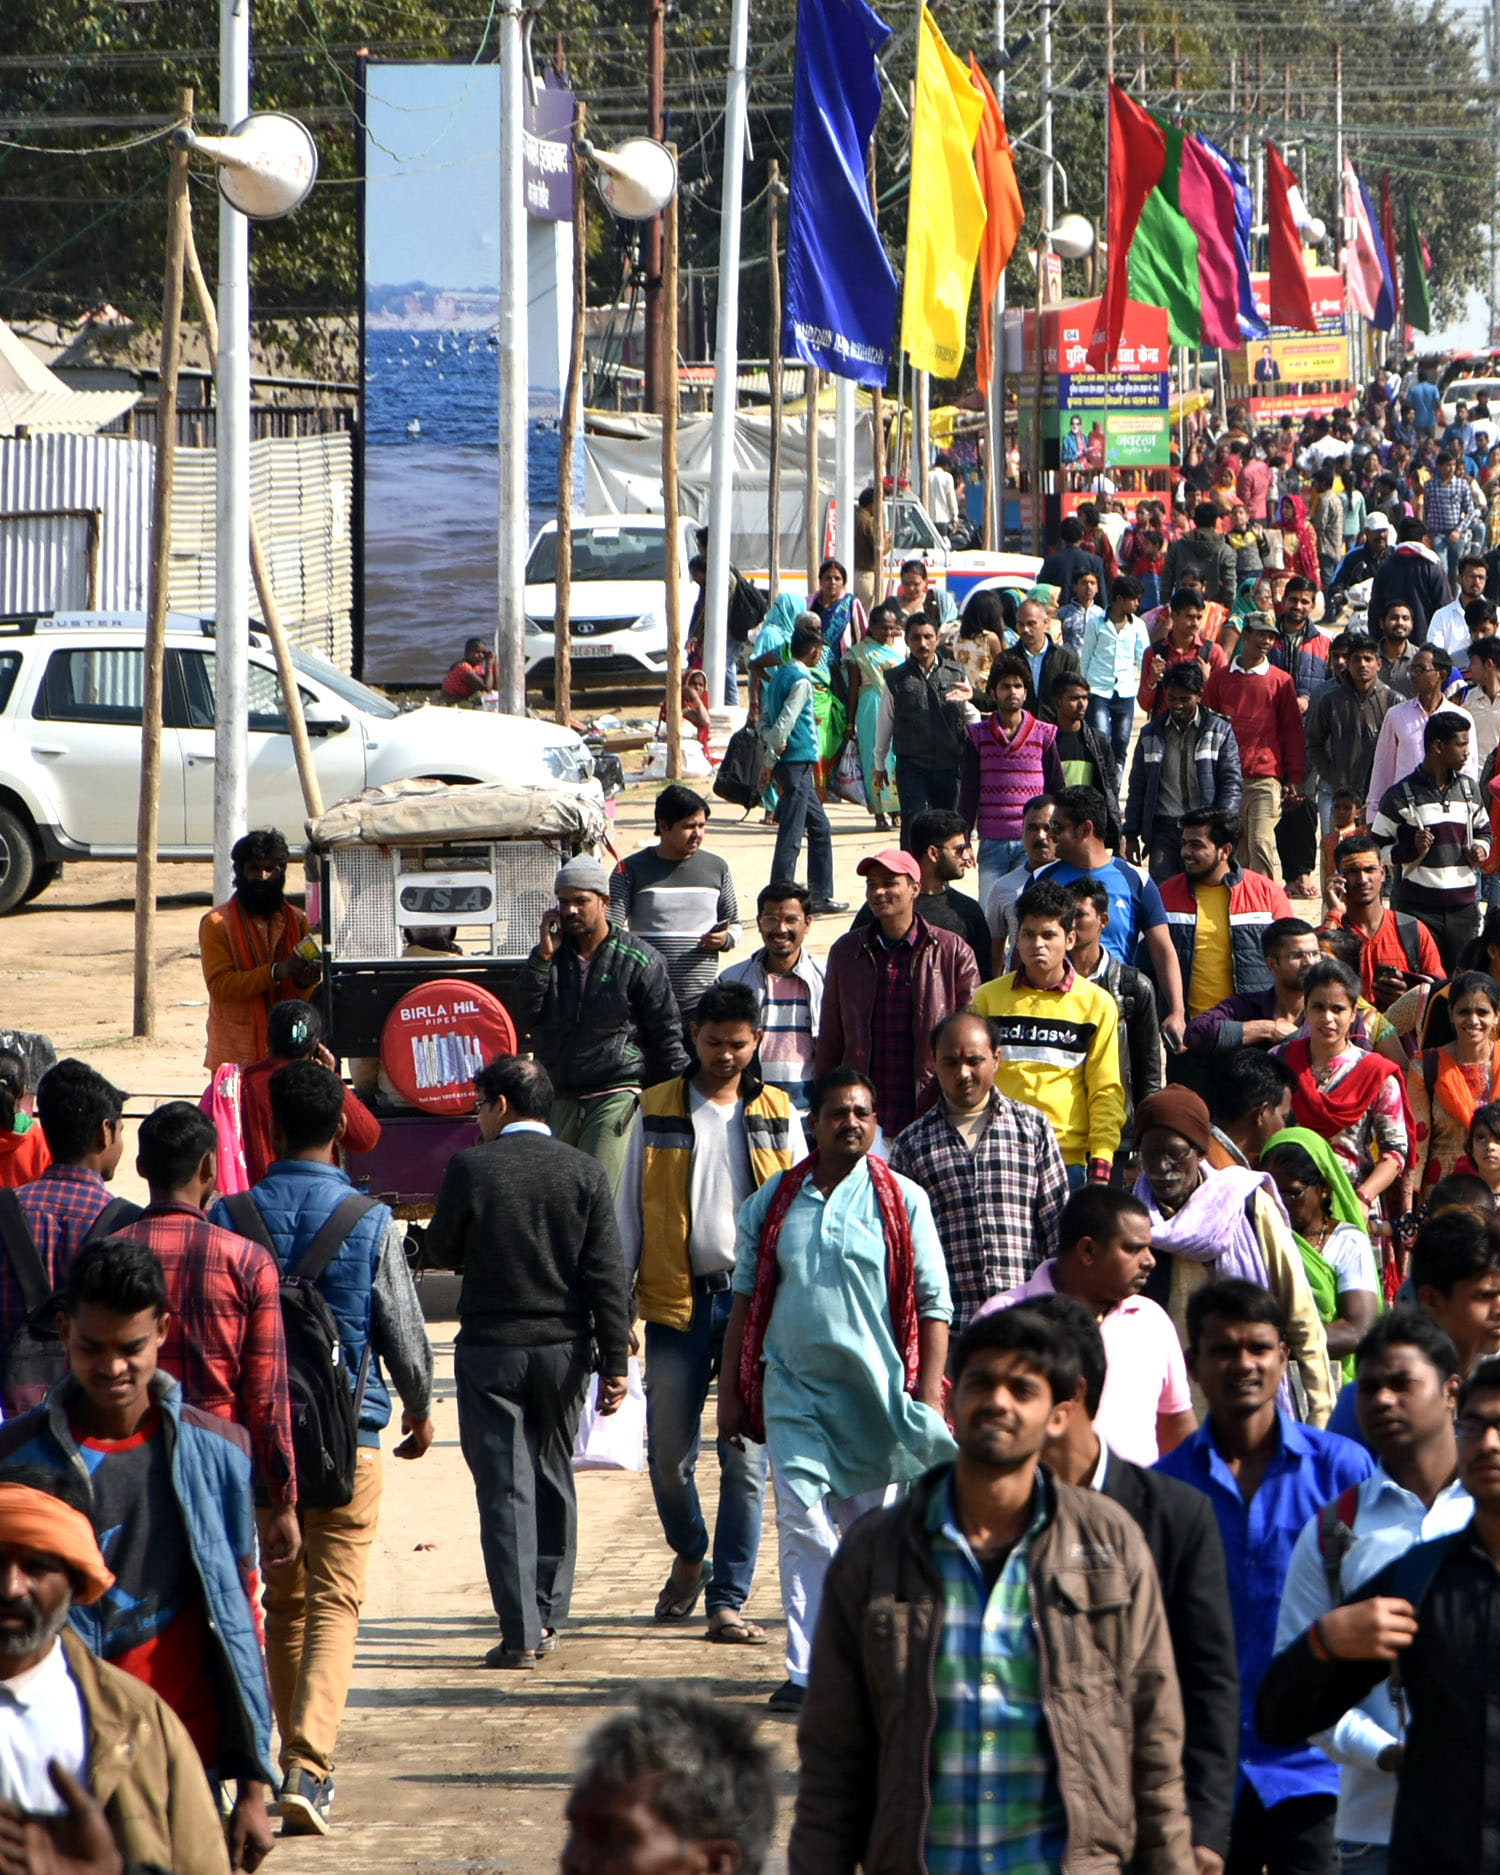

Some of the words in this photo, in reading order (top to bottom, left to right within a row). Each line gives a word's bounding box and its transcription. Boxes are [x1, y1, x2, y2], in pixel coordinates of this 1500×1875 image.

[1065, 344, 1088, 368] पुलि
[43, 619, 122, 628] DUSTER
[400, 1004, 447, 1021] BIRLA
[425, 1016, 458, 1026] PIPES
[1000, 1023, 1060, 1043] adidas
